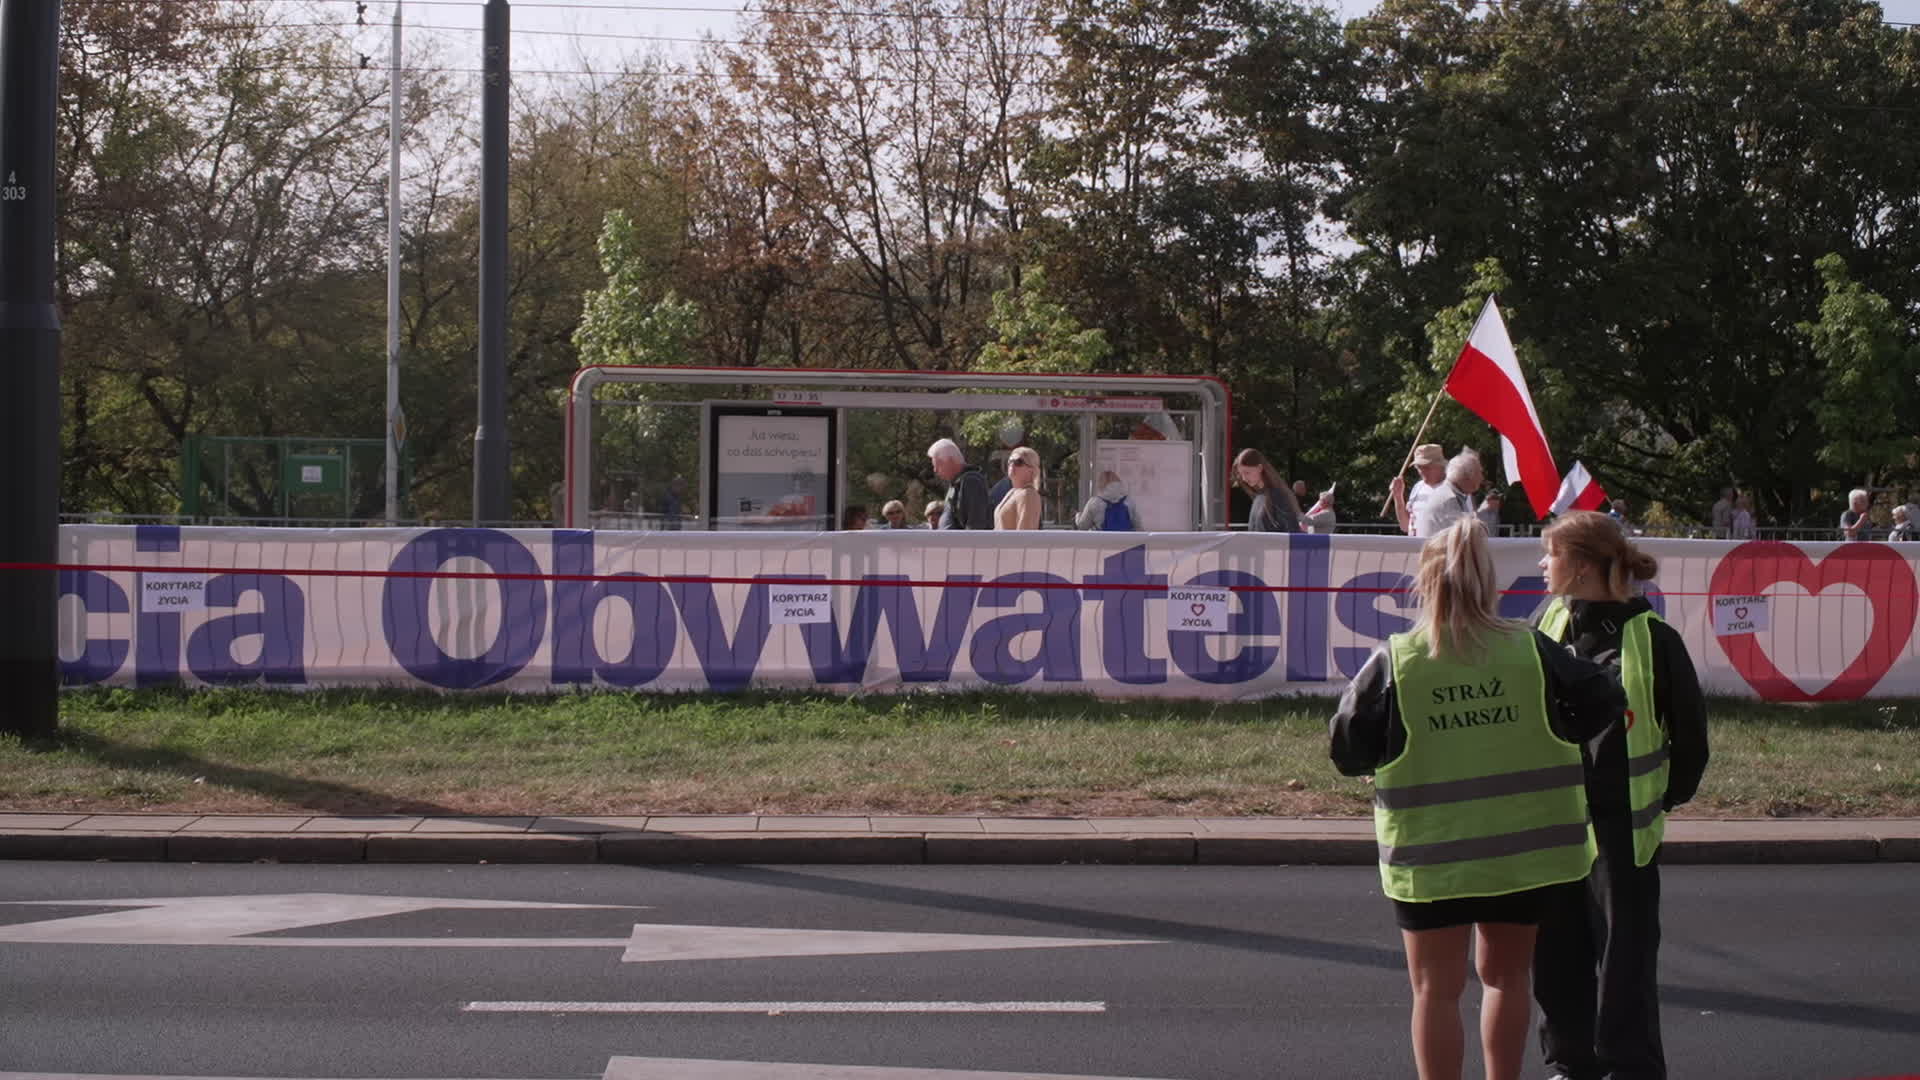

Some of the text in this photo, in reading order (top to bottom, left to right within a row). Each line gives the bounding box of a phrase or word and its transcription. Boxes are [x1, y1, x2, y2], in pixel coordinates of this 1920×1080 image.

[8, 170, 17, 184] 4
[2, 186, 26, 200] 303
[727, 447, 740, 457] co
[145, 581, 203, 591] KORYTARZ
[771, 593, 828, 603] KORYTARZ
[1170, 592, 1227, 602] KORYTARZ
[1431, 676, 1505, 705] STRAŻ
[1427, 704, 1520, 732] MARSZU
